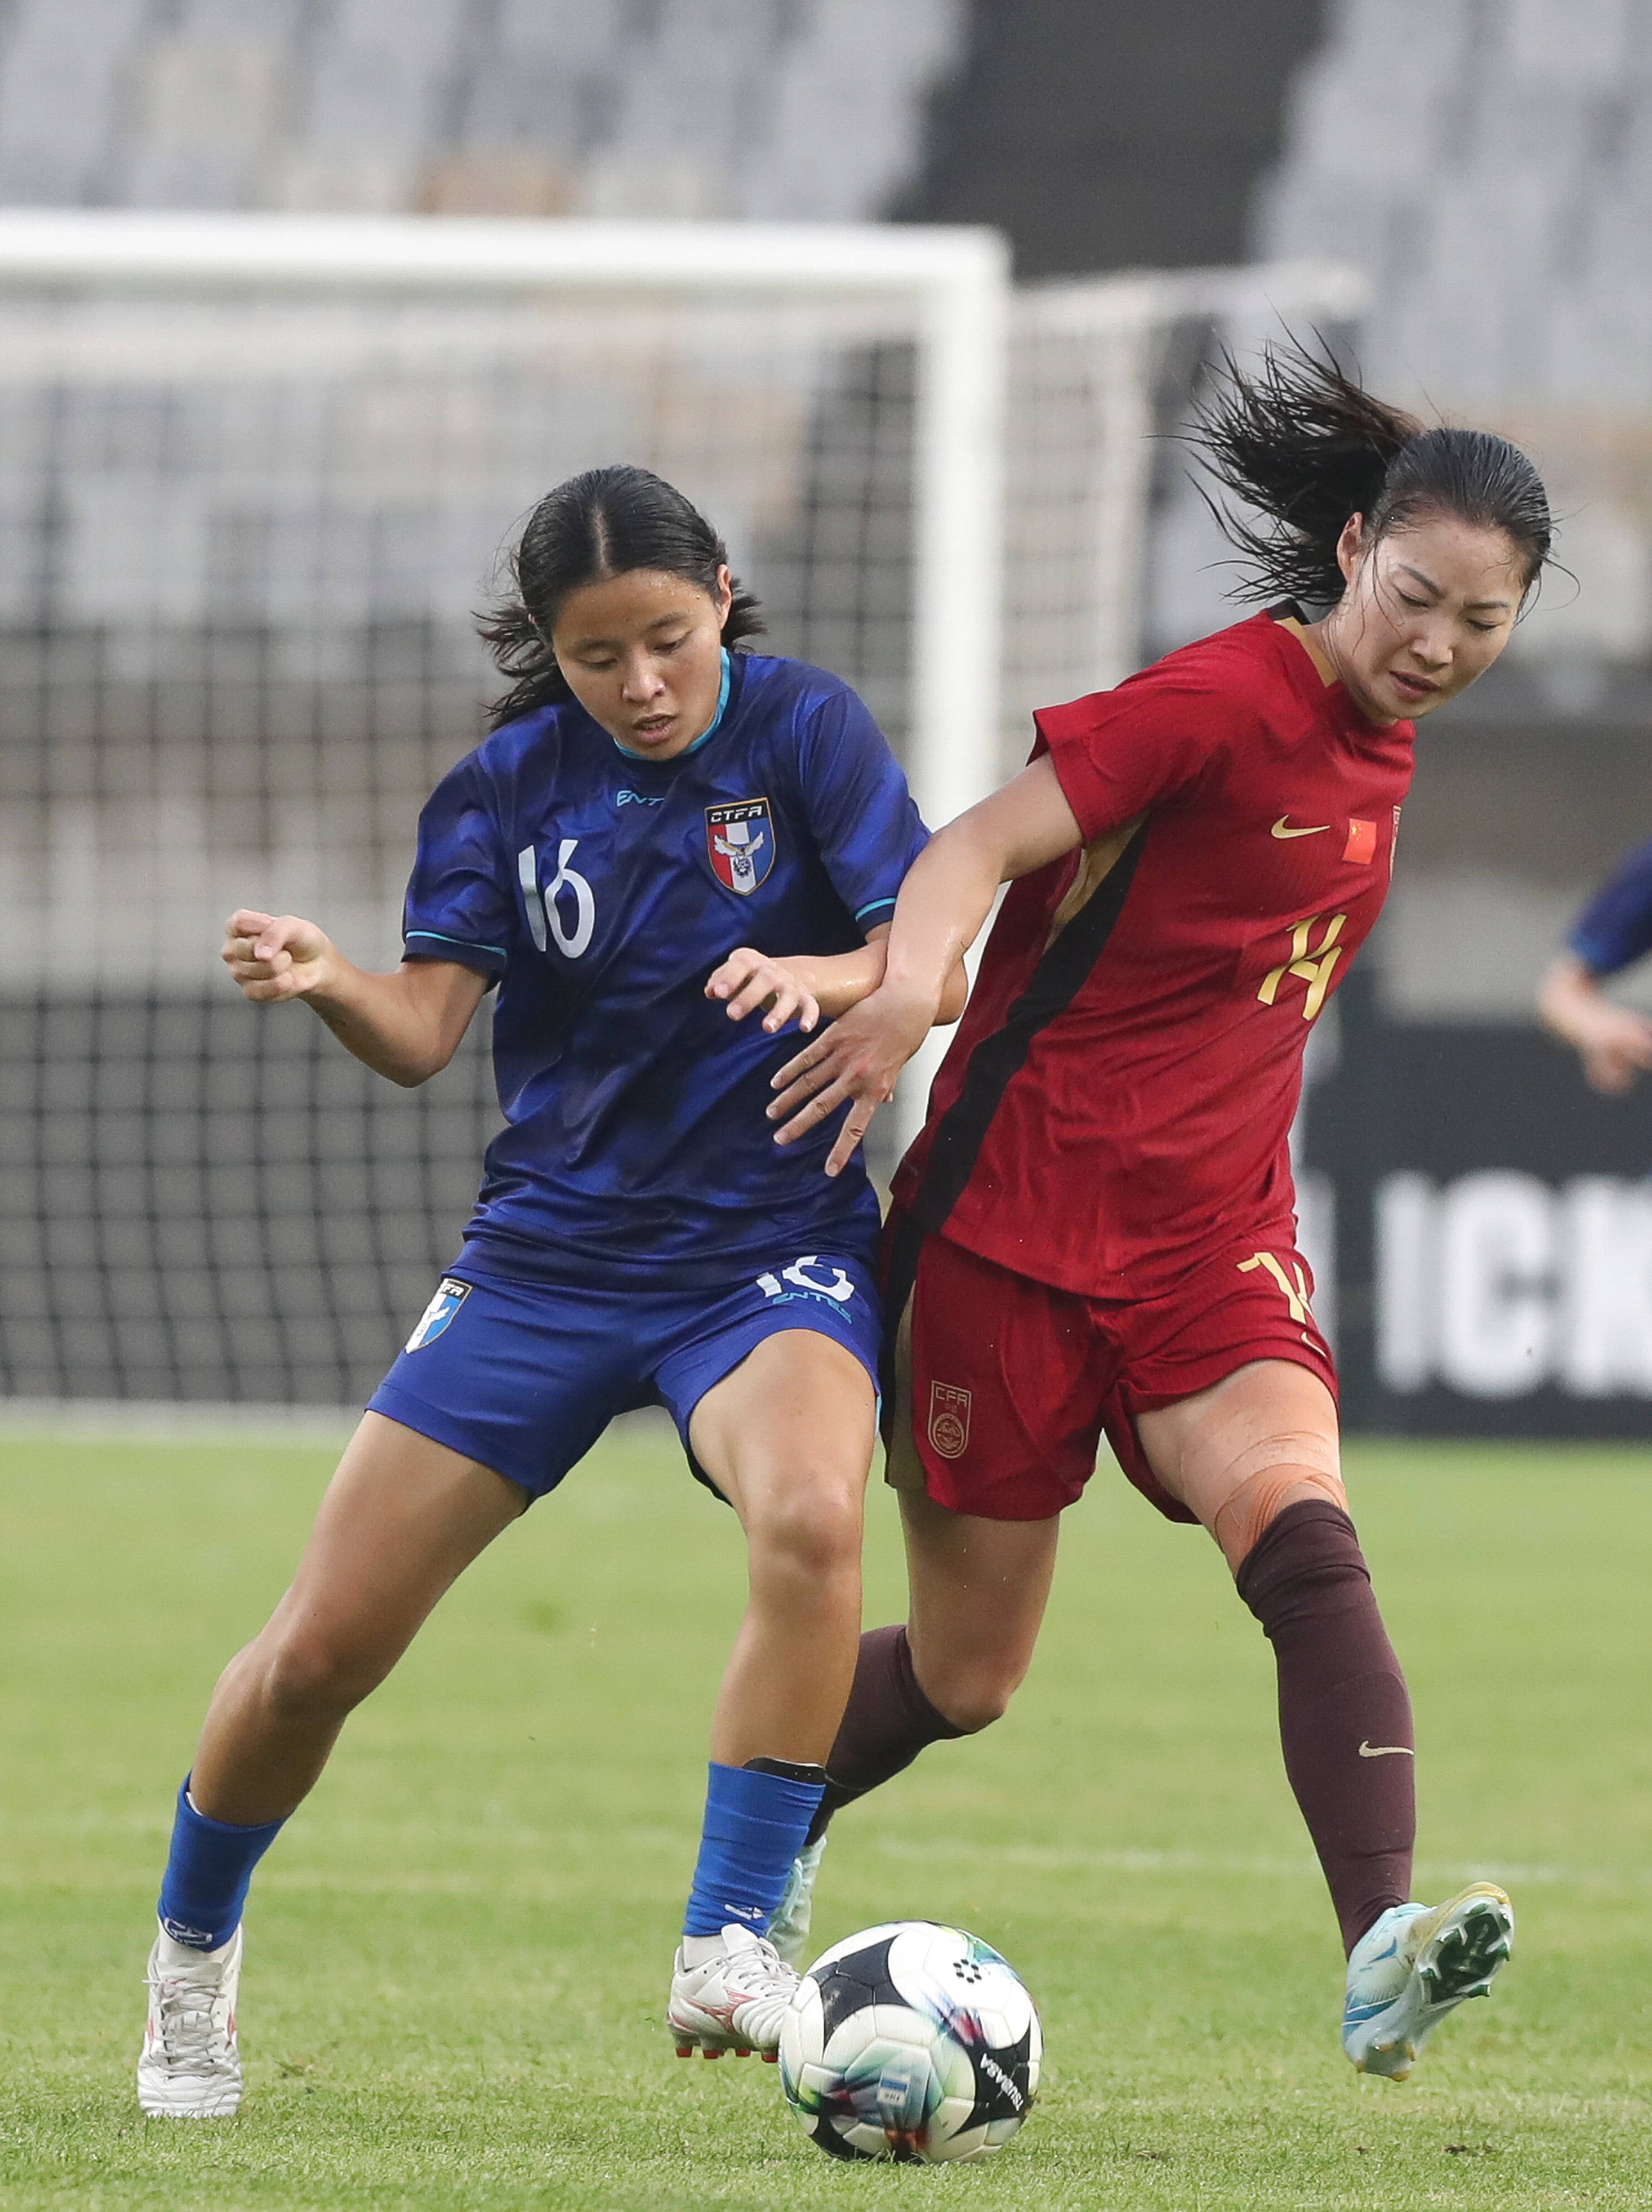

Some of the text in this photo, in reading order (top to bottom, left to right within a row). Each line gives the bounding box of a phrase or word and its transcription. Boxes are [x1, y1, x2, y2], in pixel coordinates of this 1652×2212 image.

[710, 805, 762, 823] CTFA
[518, 839, 595, 958] 16
[1257, 913, 1347, 1021] 14
[755, 1255, 855, 1302] 16
[935, 1386, 968, 1407] CFA
